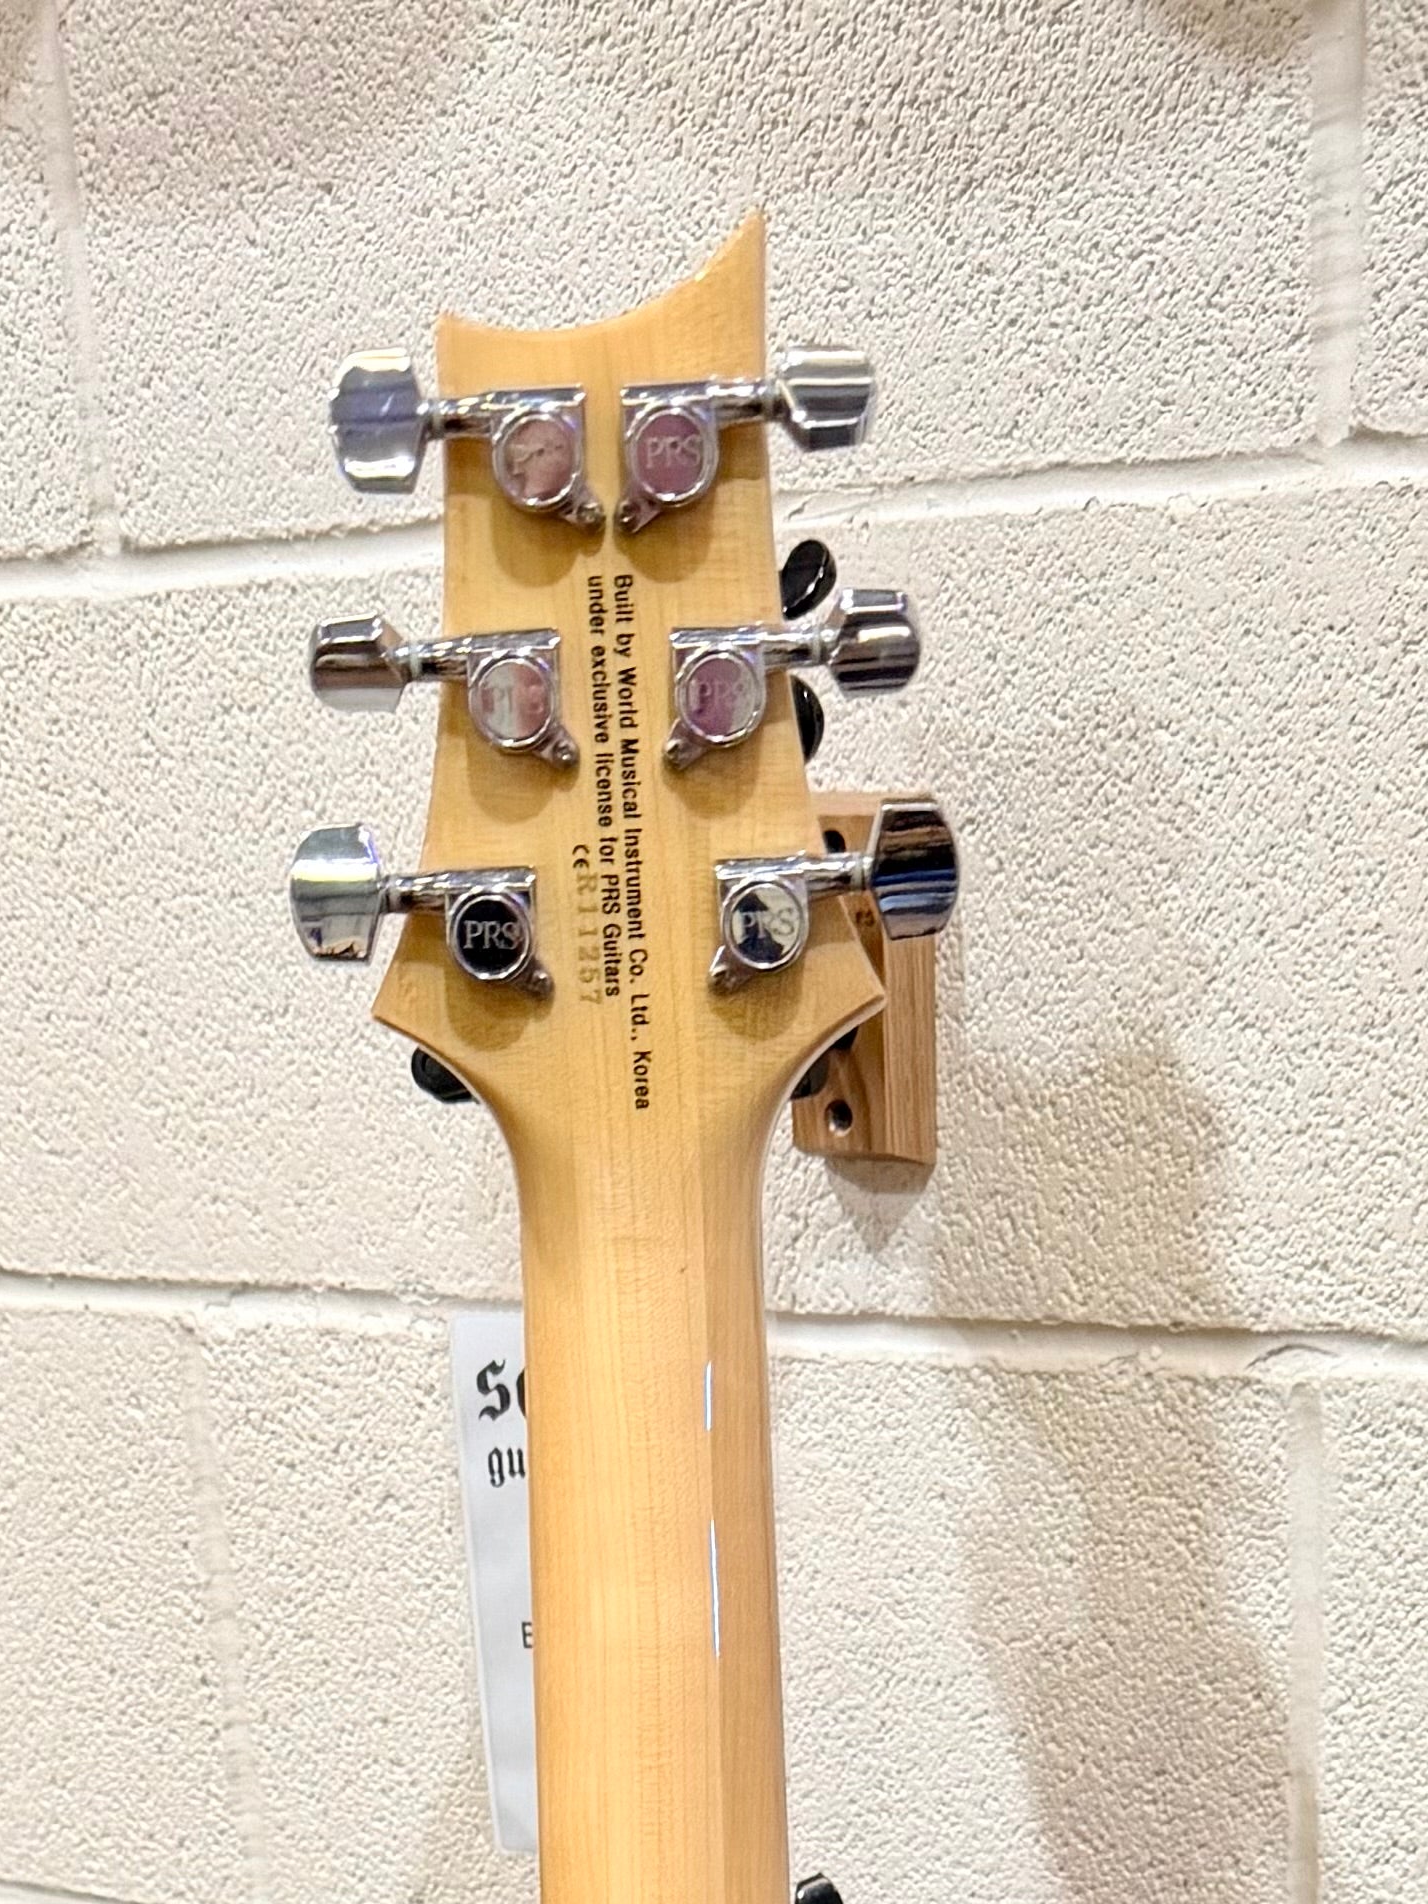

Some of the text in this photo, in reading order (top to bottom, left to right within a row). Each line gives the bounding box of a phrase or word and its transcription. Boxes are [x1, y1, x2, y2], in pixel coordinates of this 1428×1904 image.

[645, 435, 701, 469] PRS
[587, 574, 623, 998] under exclusive license for PRS Guitars
[613, 575, 653, 1110] Built by World Musical Instrument Co. Ltd., Korea
[462, 920, 521, 950] PRS
[735, 907, 795, 940] PRS
